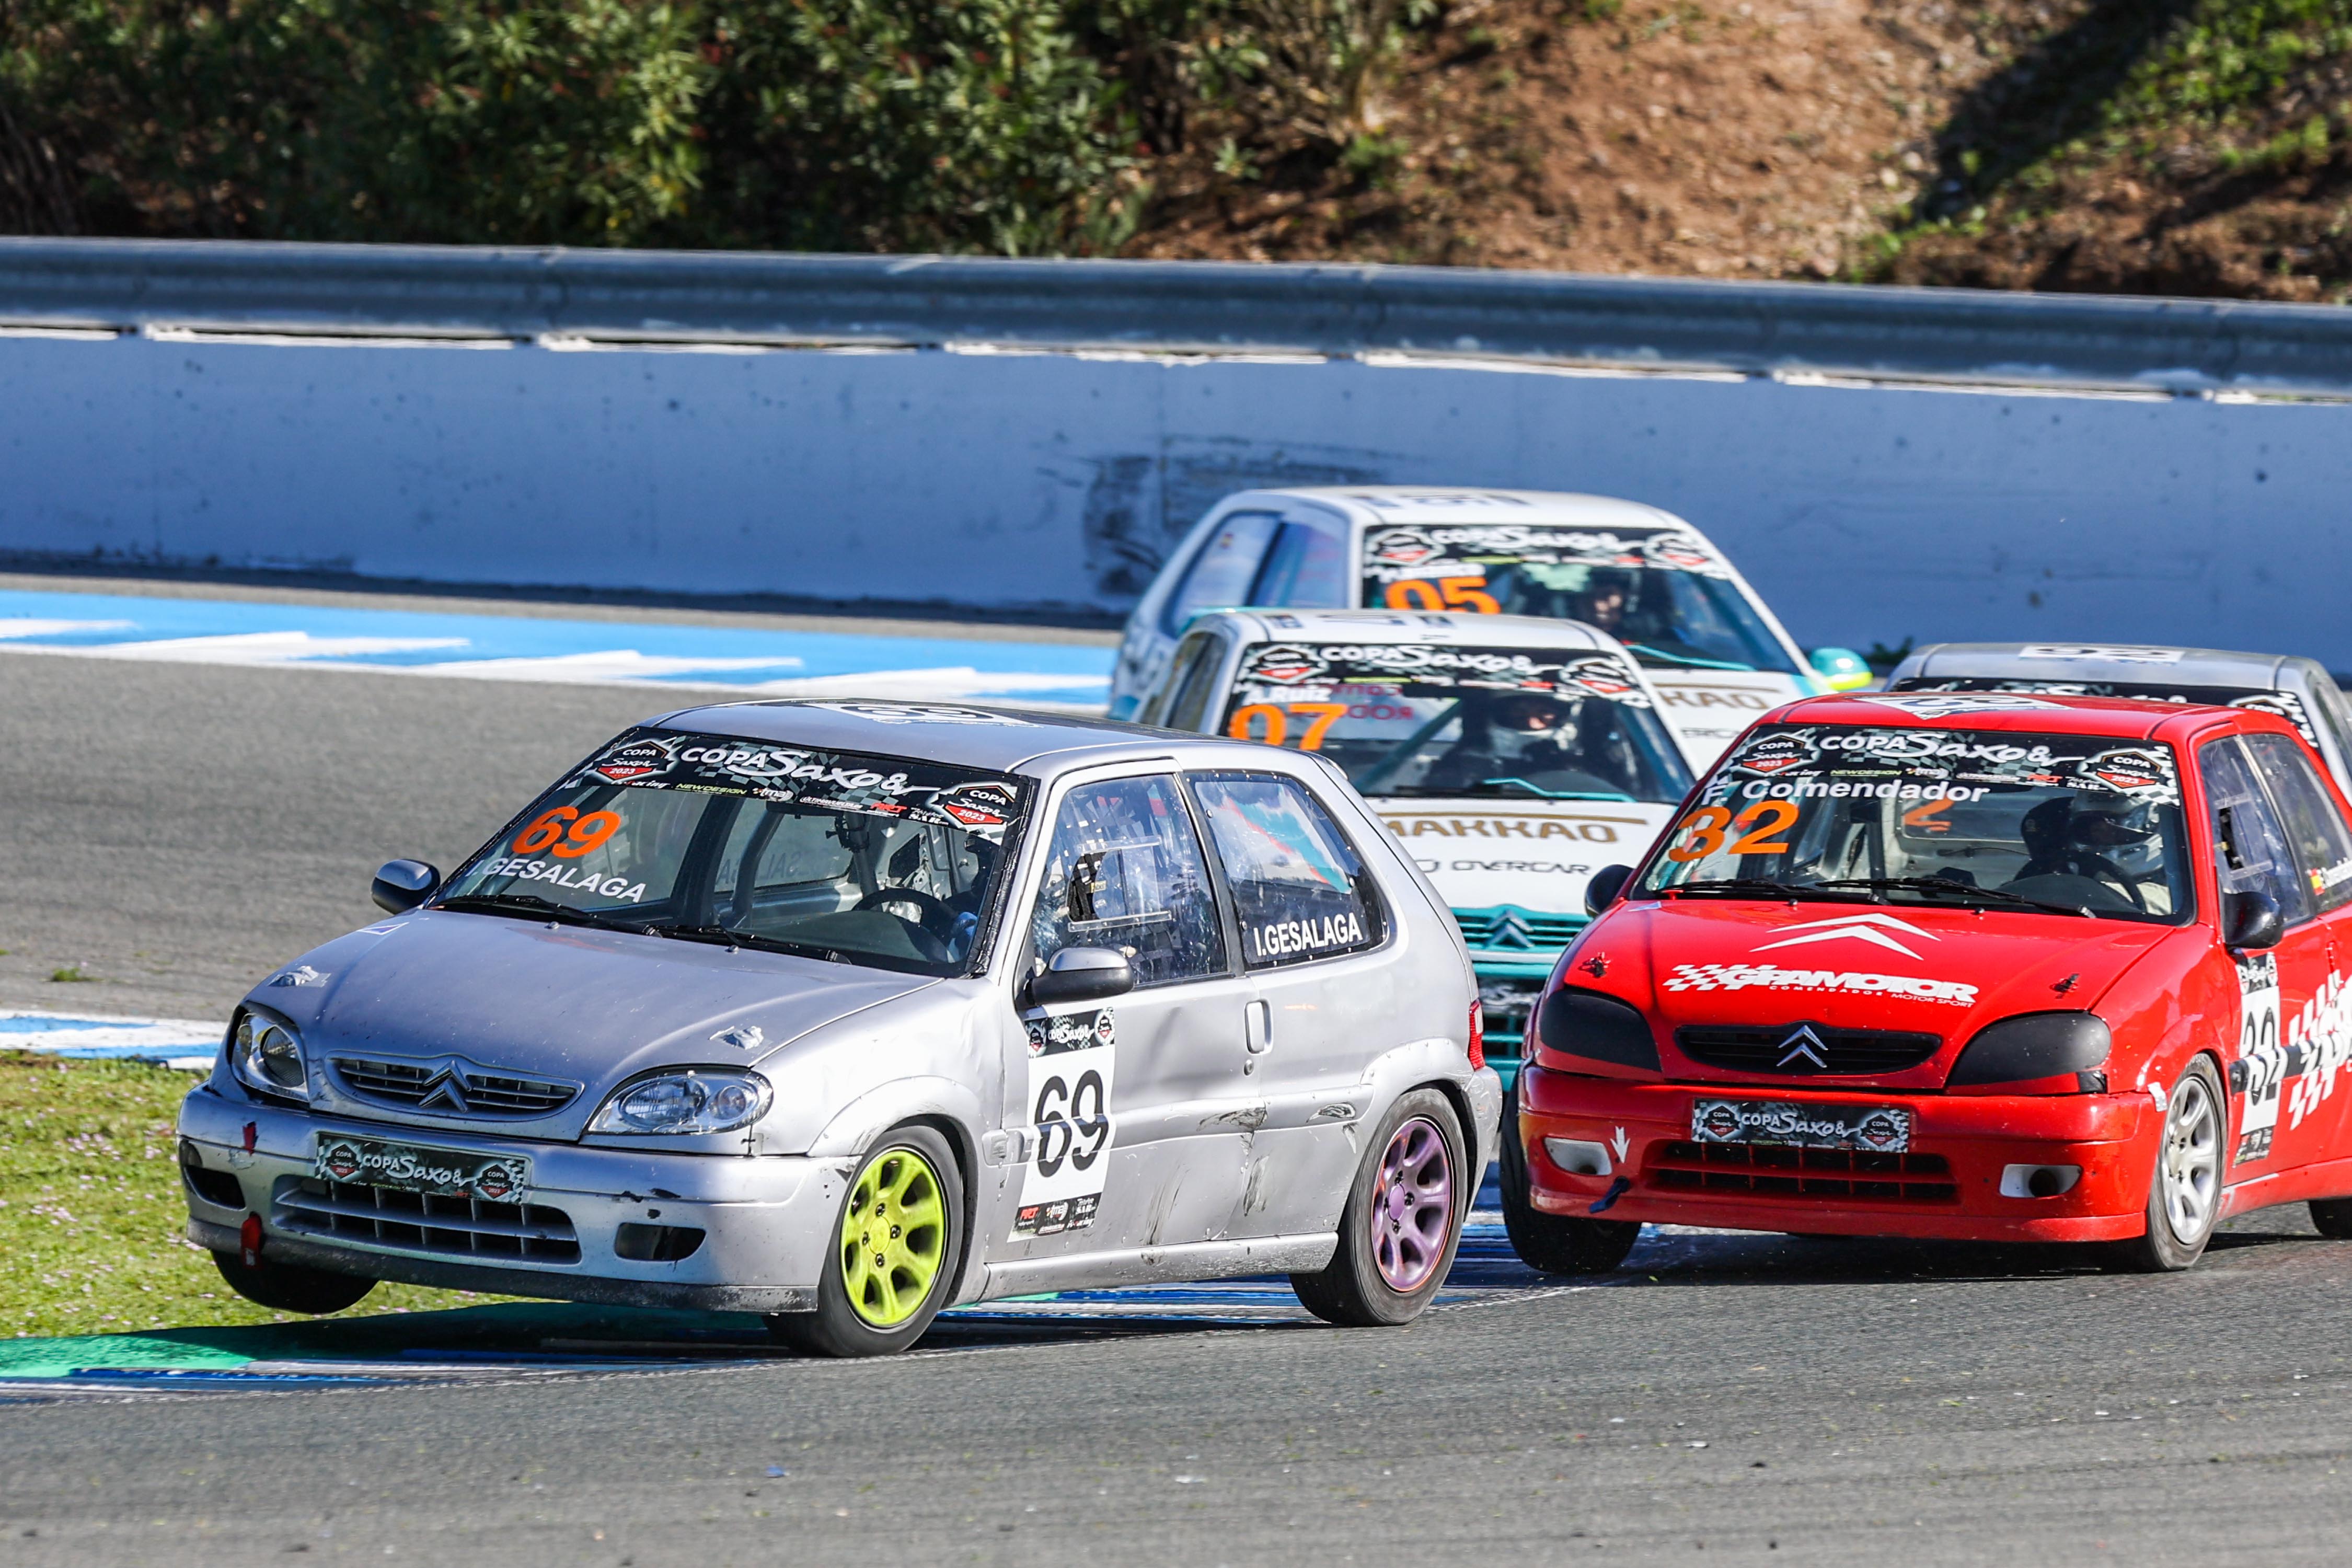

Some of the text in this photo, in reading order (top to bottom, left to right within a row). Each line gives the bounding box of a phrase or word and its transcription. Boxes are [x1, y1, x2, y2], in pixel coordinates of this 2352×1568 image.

[1386, 576, 1501, 614] 05
[1320, 645, 1403, 666] COPA
[1228, 703, 1350, 751] 07
[1758, 741, 1795, 750] COPA
[1819, 735, 1907, 751] COPA
[681, 747, 768, 768] COPA
[1756, 759, 1783, 768] 2023
[2113, 756, 2151, 768] COPA
[2111, 775, 2140, 784] 2023
[970, 790, 1001, 805] COPA
[1742, 779, 1991, 803] Comendador
[958, 809, 985, 821] 2023
[512, 806, 621, 858] 69
[1668, 800, 1800, 863] 32
[1254, 912, 1363, 956] I.GESALAGA
[1936, 998, 1975, 1008] SPORT
[1034, 1069, 1109, 1178] 69
[1740, 1114, 1781, 1128] COPA
[362, 1154, 400, 1171] COPA
